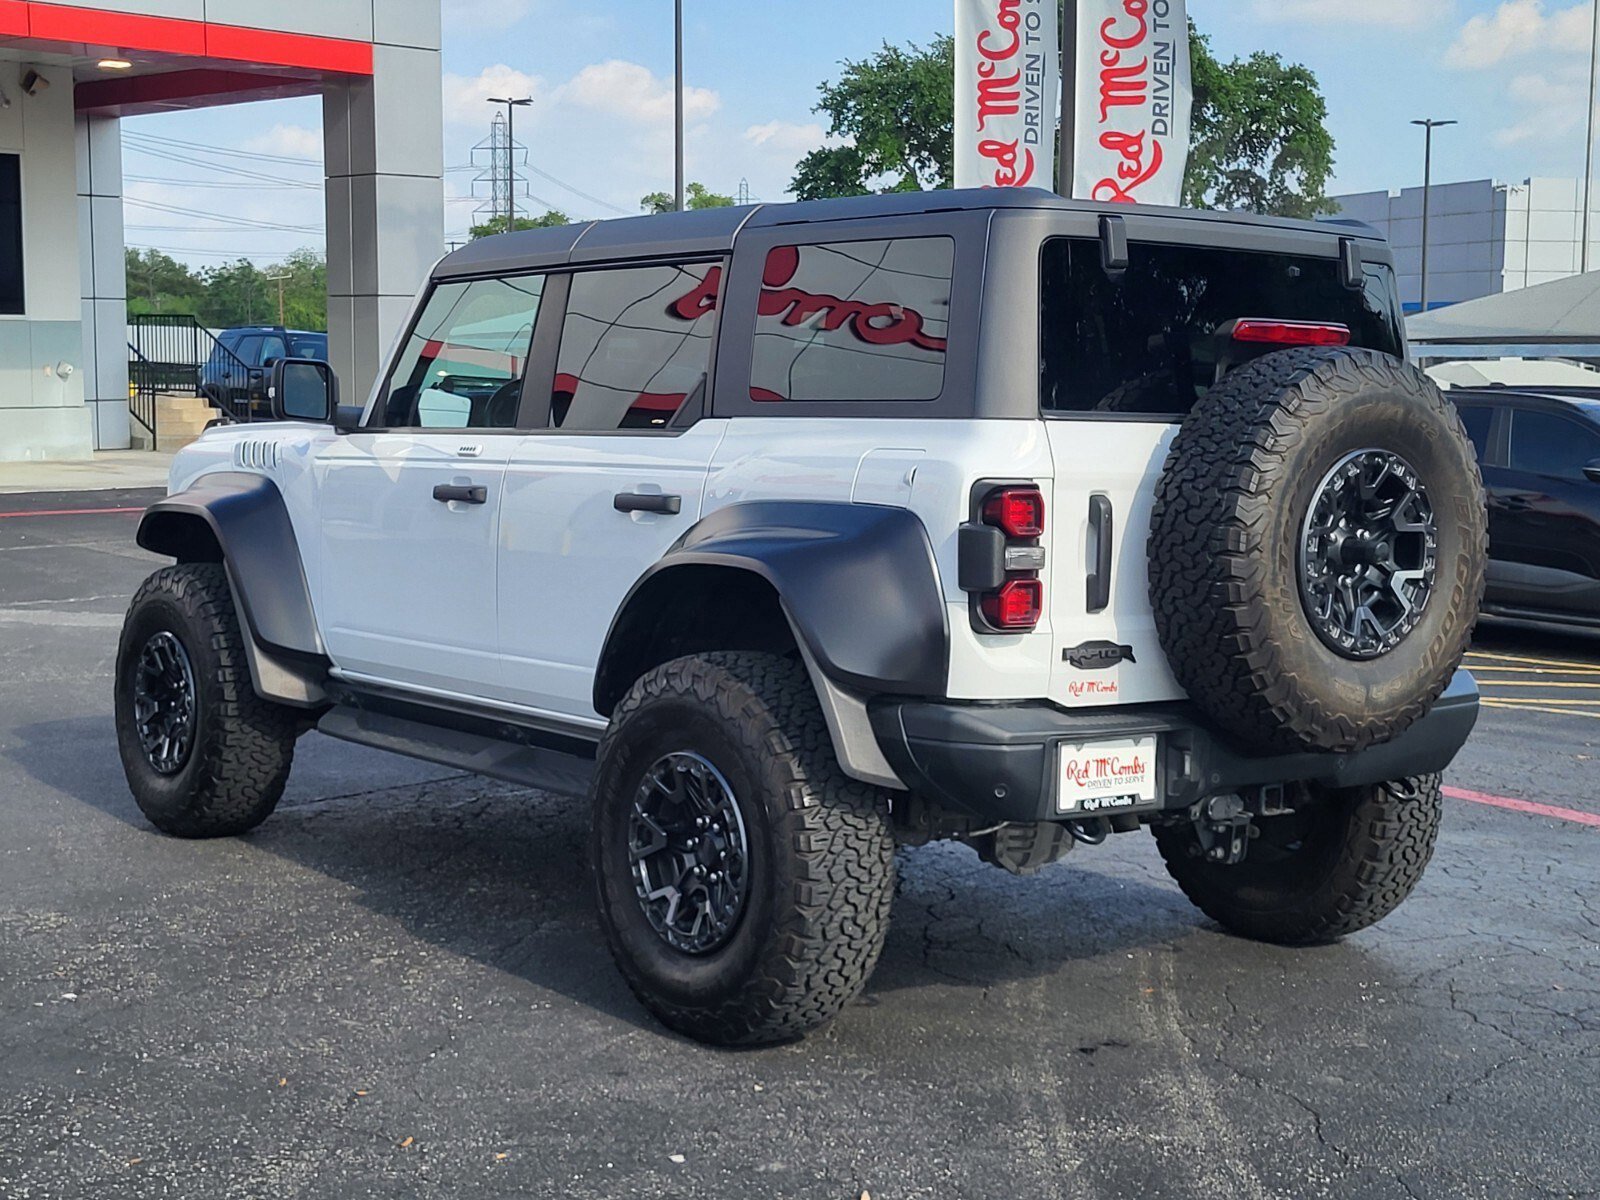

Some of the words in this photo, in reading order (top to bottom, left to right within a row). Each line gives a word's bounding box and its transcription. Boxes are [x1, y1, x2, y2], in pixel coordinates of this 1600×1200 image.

[1024, 12, 1041, 46] TO
[1152, 0, 1170, 33] TO
[1023, 53, 1041, 145] DRIVEN
[1152, 41, 1171, 137] DRIVEN
[977, 139, 1035, 188] ed
[1091, 129, 1164, 204] Red
[1068, 681, 1085, 697] Red
[1086, 680, 1118, 693] McCombs
[1066, 760, 1091, 787] Red
[1092, 756, 1146, 777] McCombs
[1087, 778, 1112, 788] DRIVEN
[1114, 777, 1124, 785] TO
[1125, 775, 1145, 784] SERVE
